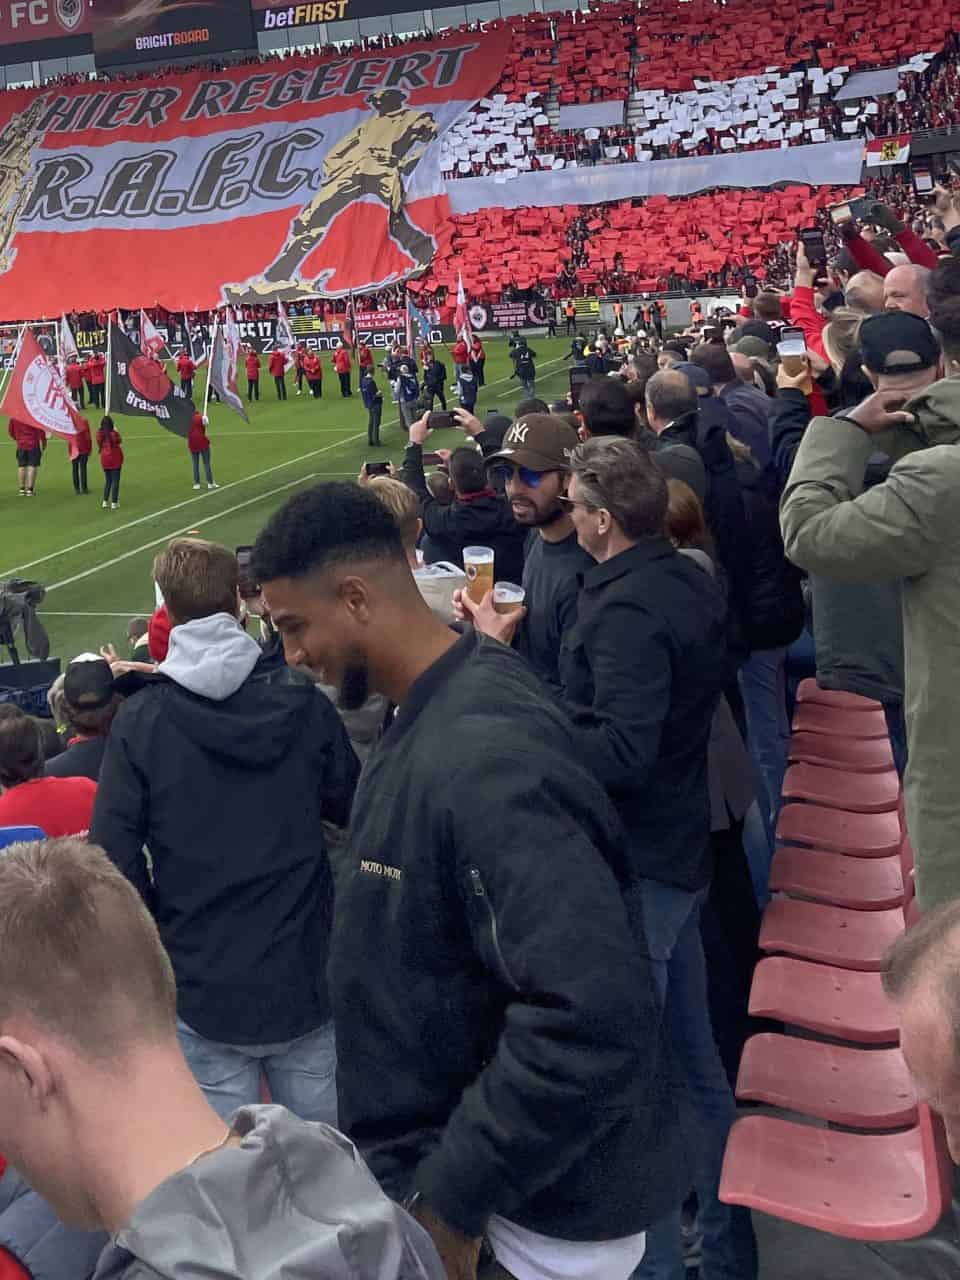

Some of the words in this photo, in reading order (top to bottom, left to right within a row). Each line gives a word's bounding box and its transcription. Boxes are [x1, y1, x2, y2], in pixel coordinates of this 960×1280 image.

[10, 0, 49, 29] FC
[264, 0, 349, 29] betFIRST
[135, 28, 209, 50] BRIGHTBOARD
[37, 86, 181, 133] HIER
[181, 42, 480, 120] REGEERT
[508, 423, 529, 442] NY
[360, 859, 382, 874] MOTO
